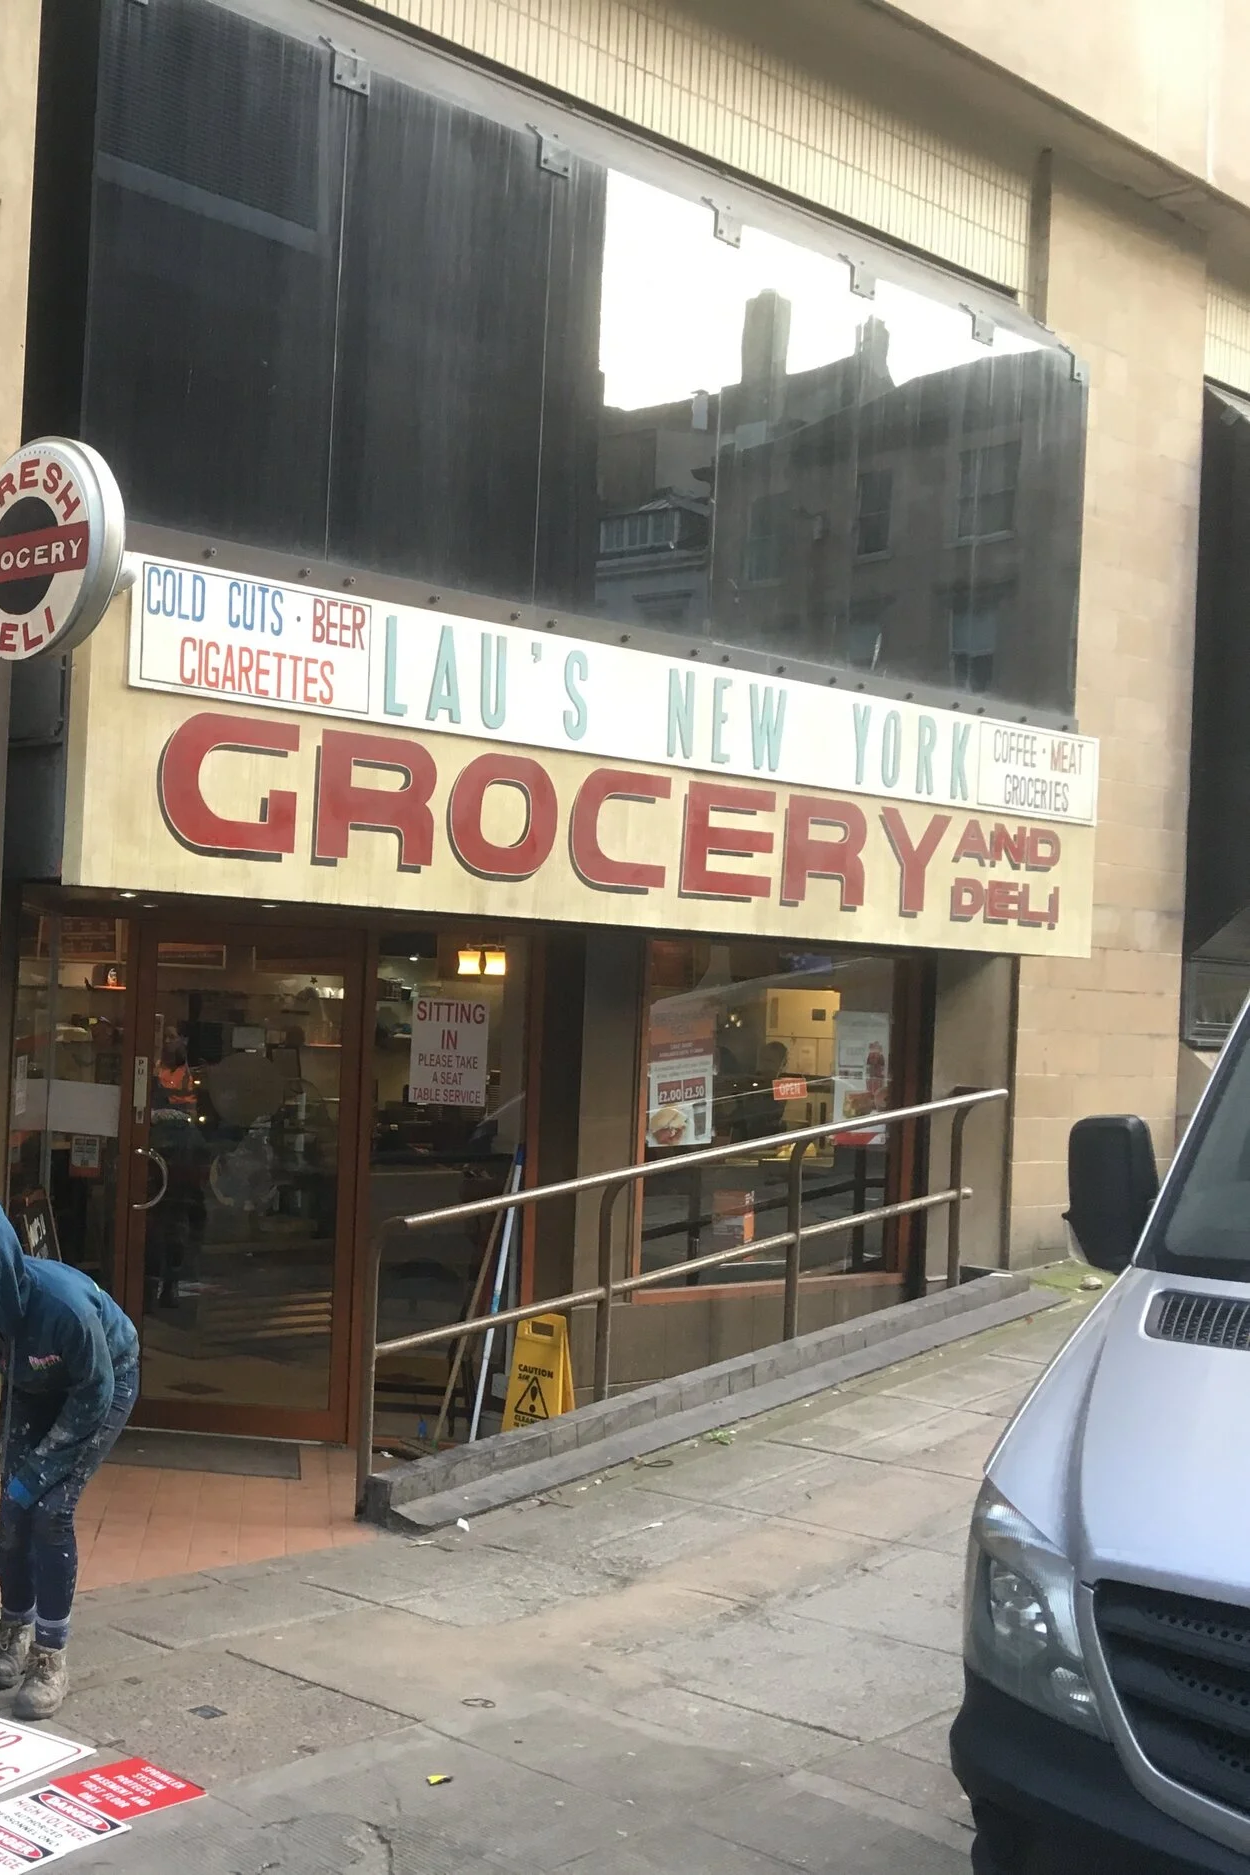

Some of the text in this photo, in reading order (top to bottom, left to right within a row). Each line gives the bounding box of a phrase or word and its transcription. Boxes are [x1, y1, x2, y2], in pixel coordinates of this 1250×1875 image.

[146, 566, 366, 650] COLD CUTS BEER
[180, 637, 335, 705] CIGARETTES
[384, 614, 972, 801] LAU'S NEW YORK
[993, 728, 1084, 776] COFFEE MEAT
[1004, 774, 1070, 813] GROCERIES
[157, 712, 953, 918] GROCERY
[951, 819, 1062, 872] AND
[950, 877, 1060, 931] DELI
[417, 1000, 485, 1025] SITTING
[441, 1029, 458, 1050] IN
[418, 1053, 478, 1069] PLEASE TAKE
[432, 1071, 463, 1085] A SEAT
[779, 1083, 801, 1096] OPEN
[413, 1087, 481, 1104] TABLE SERVICE
[658, 1088, 682, 1103] £2.00
[684, 1085, 705, 1099] £2.50
[518, 1364, 554, 1380] CAUTION
[89, 1773, 151, 1807] BASEMENT AND
[113, 1775, 156, 1797] PROTECTS
[132, 1773, 167, 1791] SYSTEM
[141, 1766, 187, 1789] SPRINKLER
[78, 1792, 103, 1804] ONLY
[79, 1781, 131, 1808] FIRST FLOOR
[14, 1799, 92, 1841] HIGH VOLTAGE
[14, 1811, 63, 1839] AUTHORIZED
[46, 1796, 106, 1829] DANGER
[37, 1833, 61, 1848] ONLY
